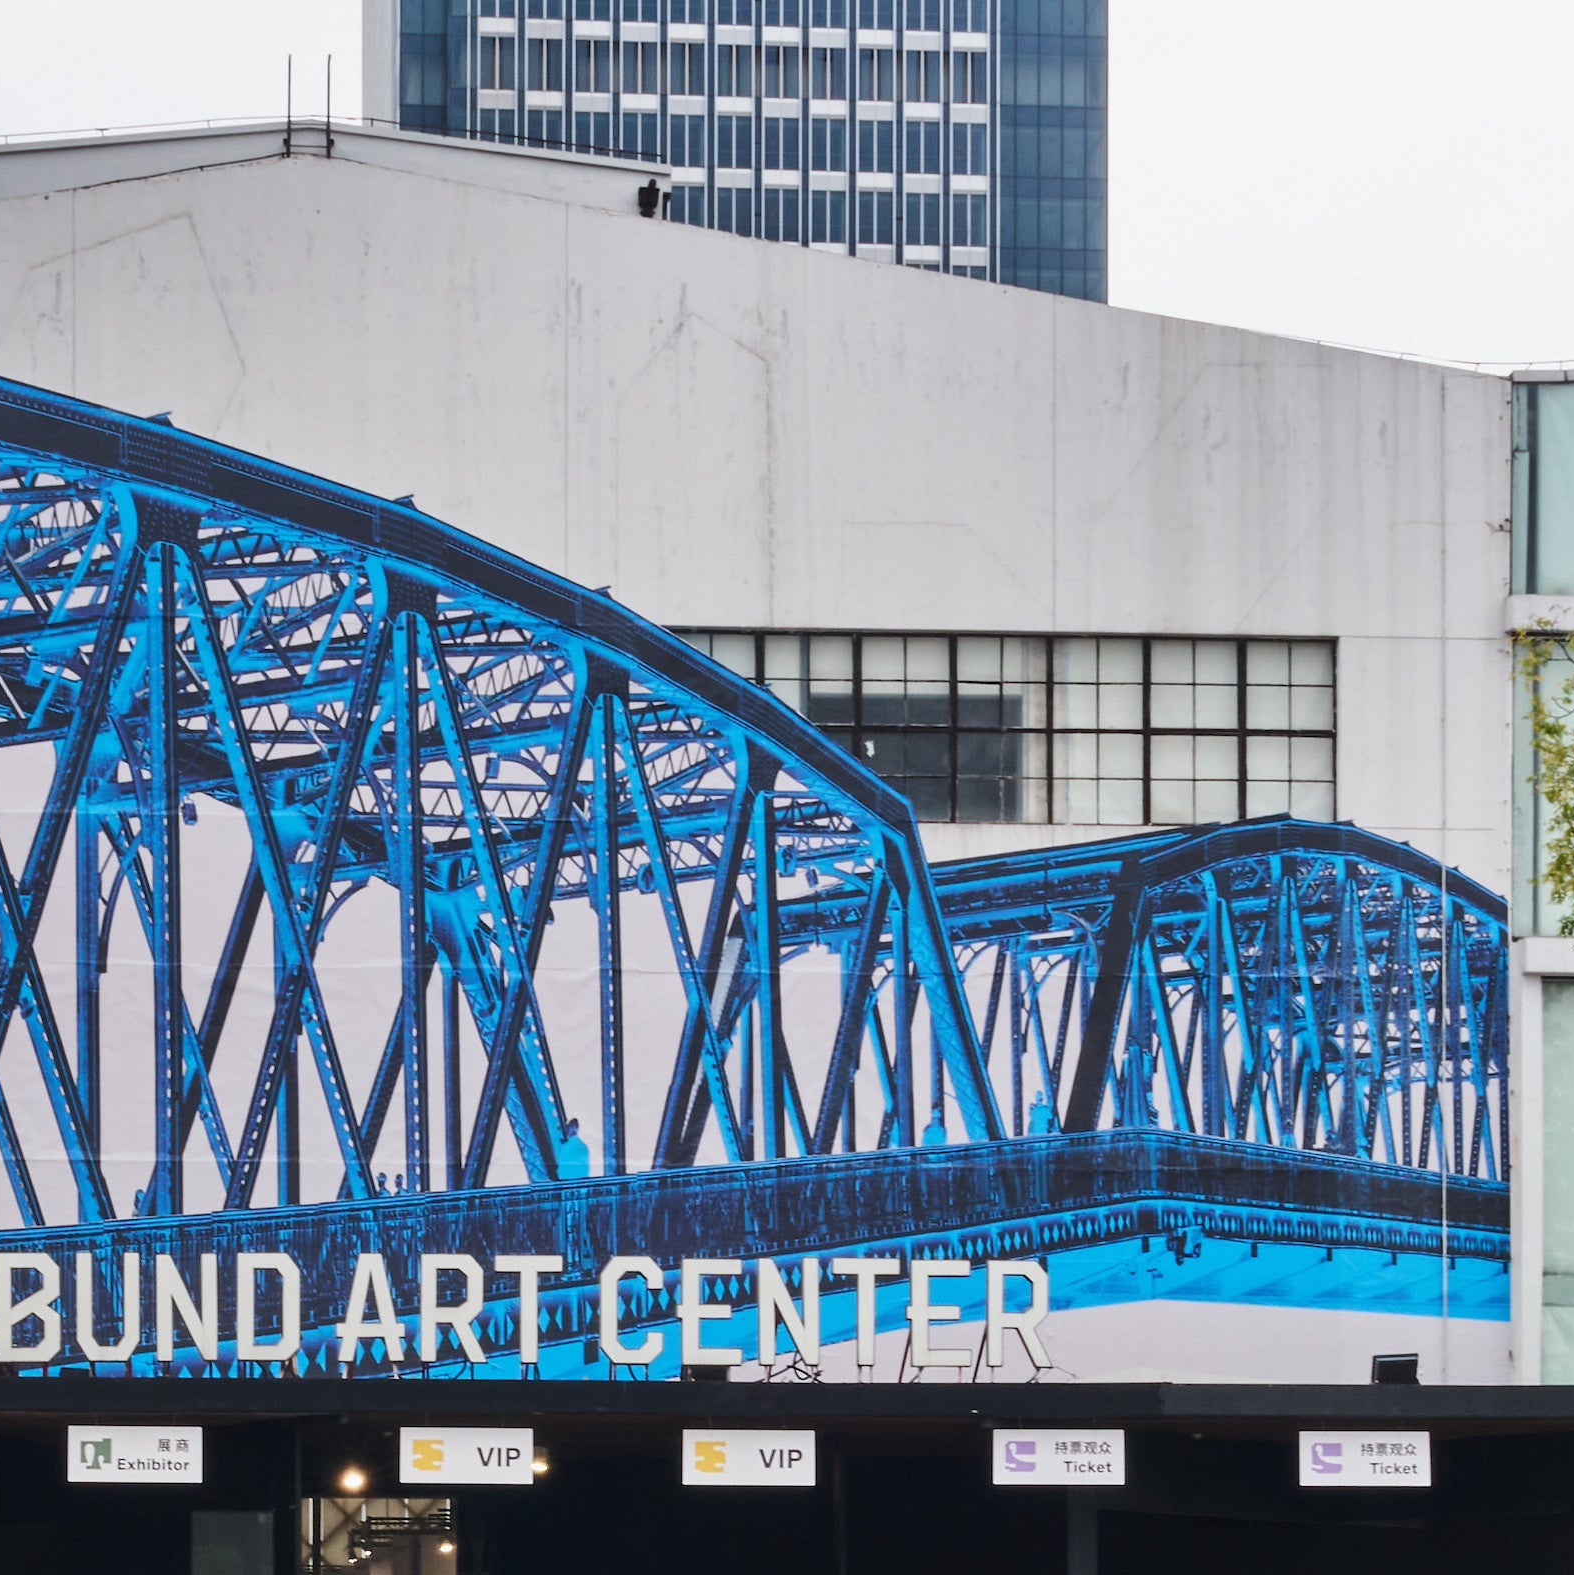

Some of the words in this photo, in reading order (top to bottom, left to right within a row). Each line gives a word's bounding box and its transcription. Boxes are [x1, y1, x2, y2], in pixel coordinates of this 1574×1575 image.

[334, 1252, 564, 1365] ART
[599, 1255, 1054, 1369] CENTER
[157, 1438, 189, 1452] 展商
[1055, 1441, 1112, 1454] 持票观众
[1361, 1443, 1417, 1456] 持票观众
[477, 1447, 521, 1467] VIP
[759, 1449, 803, 1468] VIP
[117, 1458, 190, 1470] Exhibitor
[1064, 1461, 1112, 1473] Ticket
[1370, 1462, 1418, 1474] Ticket
